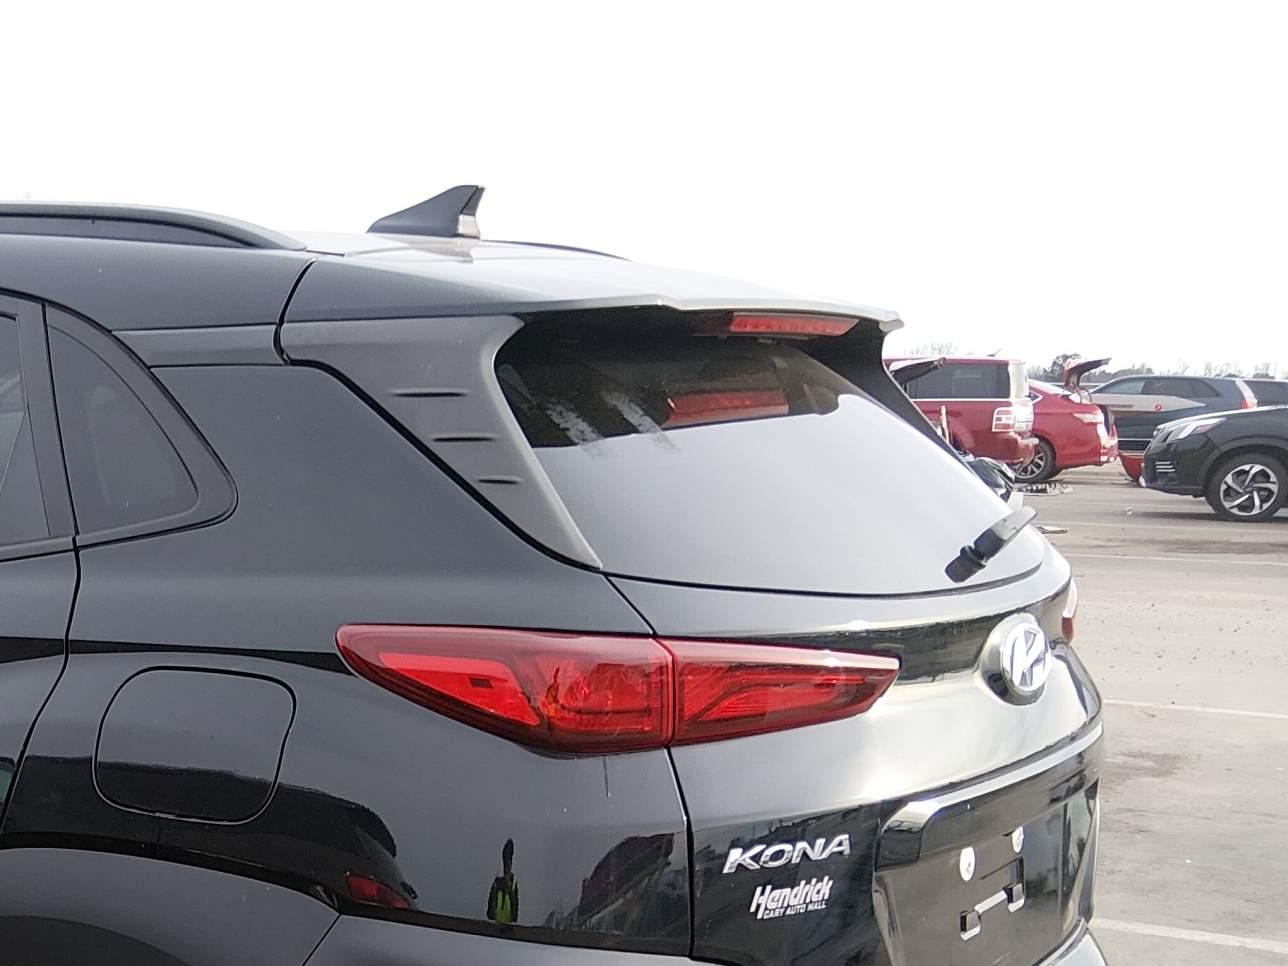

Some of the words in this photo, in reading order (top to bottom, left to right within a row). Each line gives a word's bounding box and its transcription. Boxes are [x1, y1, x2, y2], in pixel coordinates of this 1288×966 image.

[722, 833, 851, 874] KONA
[749, 875, 833, 920] Hendrick
[763, 907, 786, 919] CARY
[785, 903, 807, 915] AUTO
[806, 900, 827, 912] MALL
